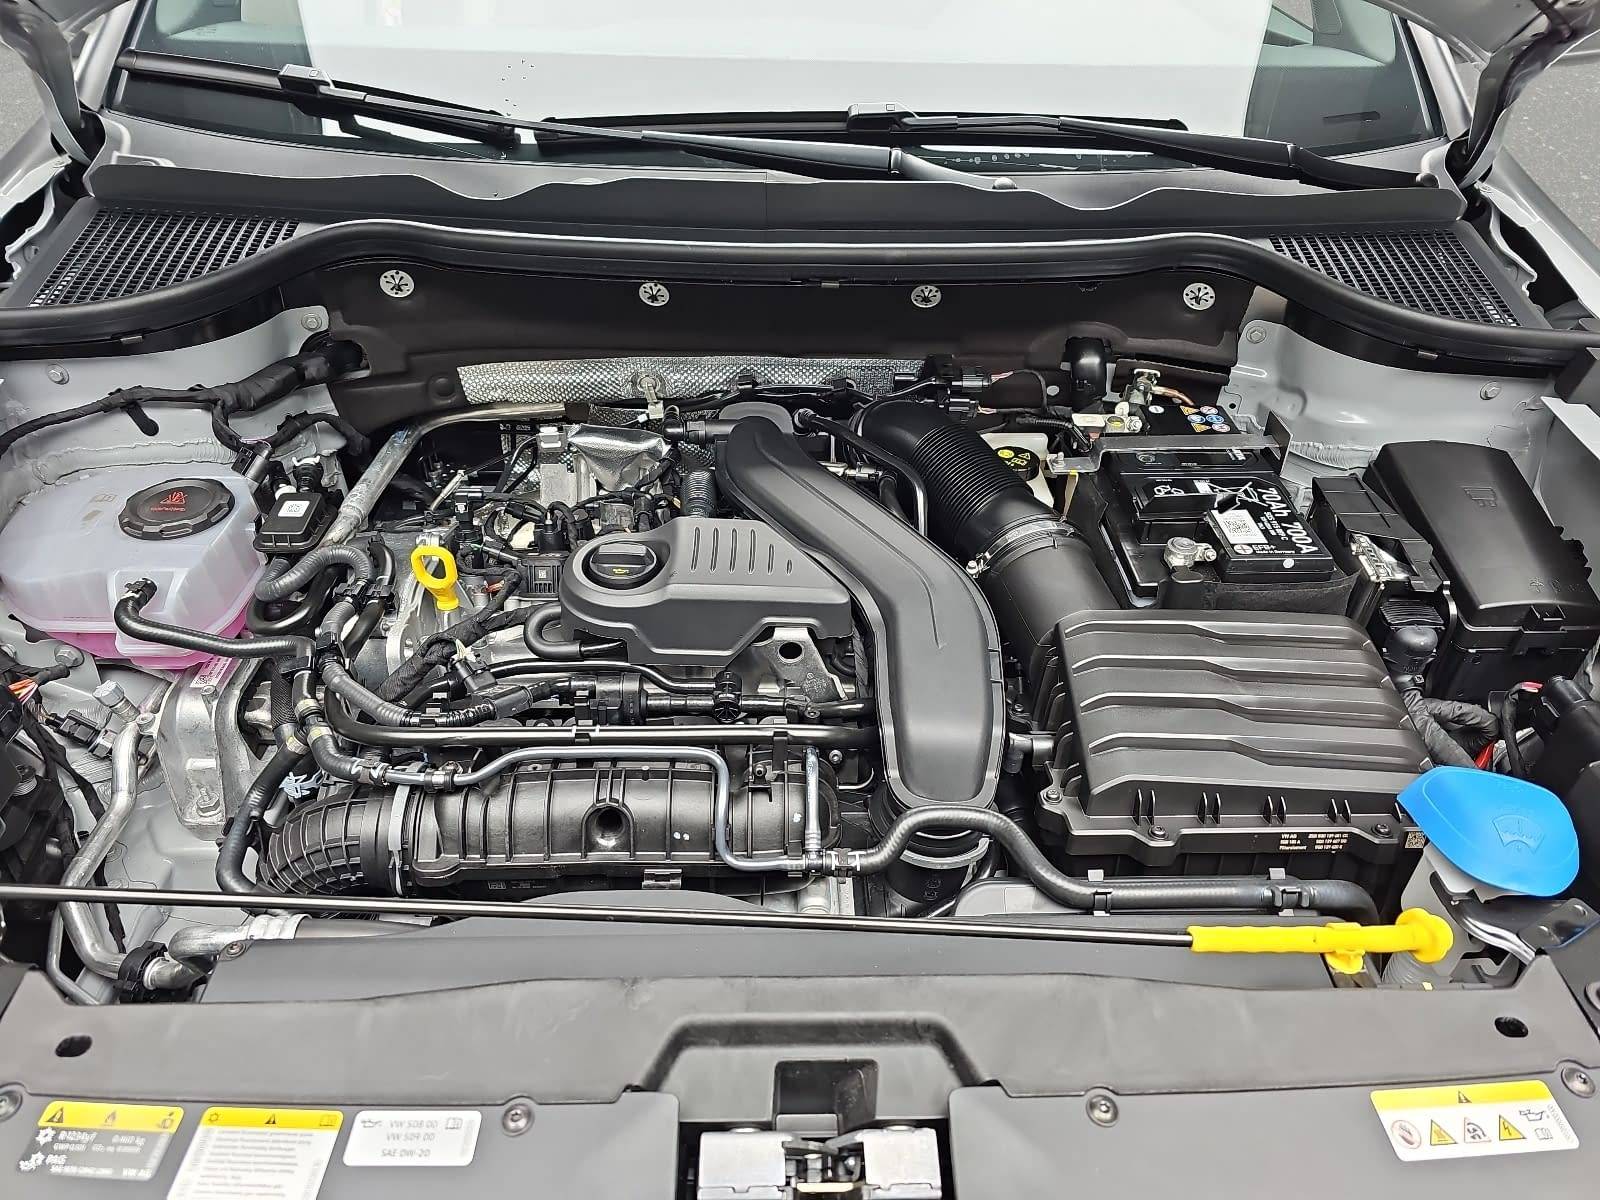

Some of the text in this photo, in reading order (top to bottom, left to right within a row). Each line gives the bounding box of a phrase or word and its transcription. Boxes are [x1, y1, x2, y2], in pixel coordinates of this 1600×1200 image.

[1257, 487, 1292, 517] 70Ah
[1281, 521, 1319, 554] 700A
[425, 1119, 439, 1129] 00
[422, 1132, 436, 1141] 00
[381, 1148, 398, 1157] SAE
